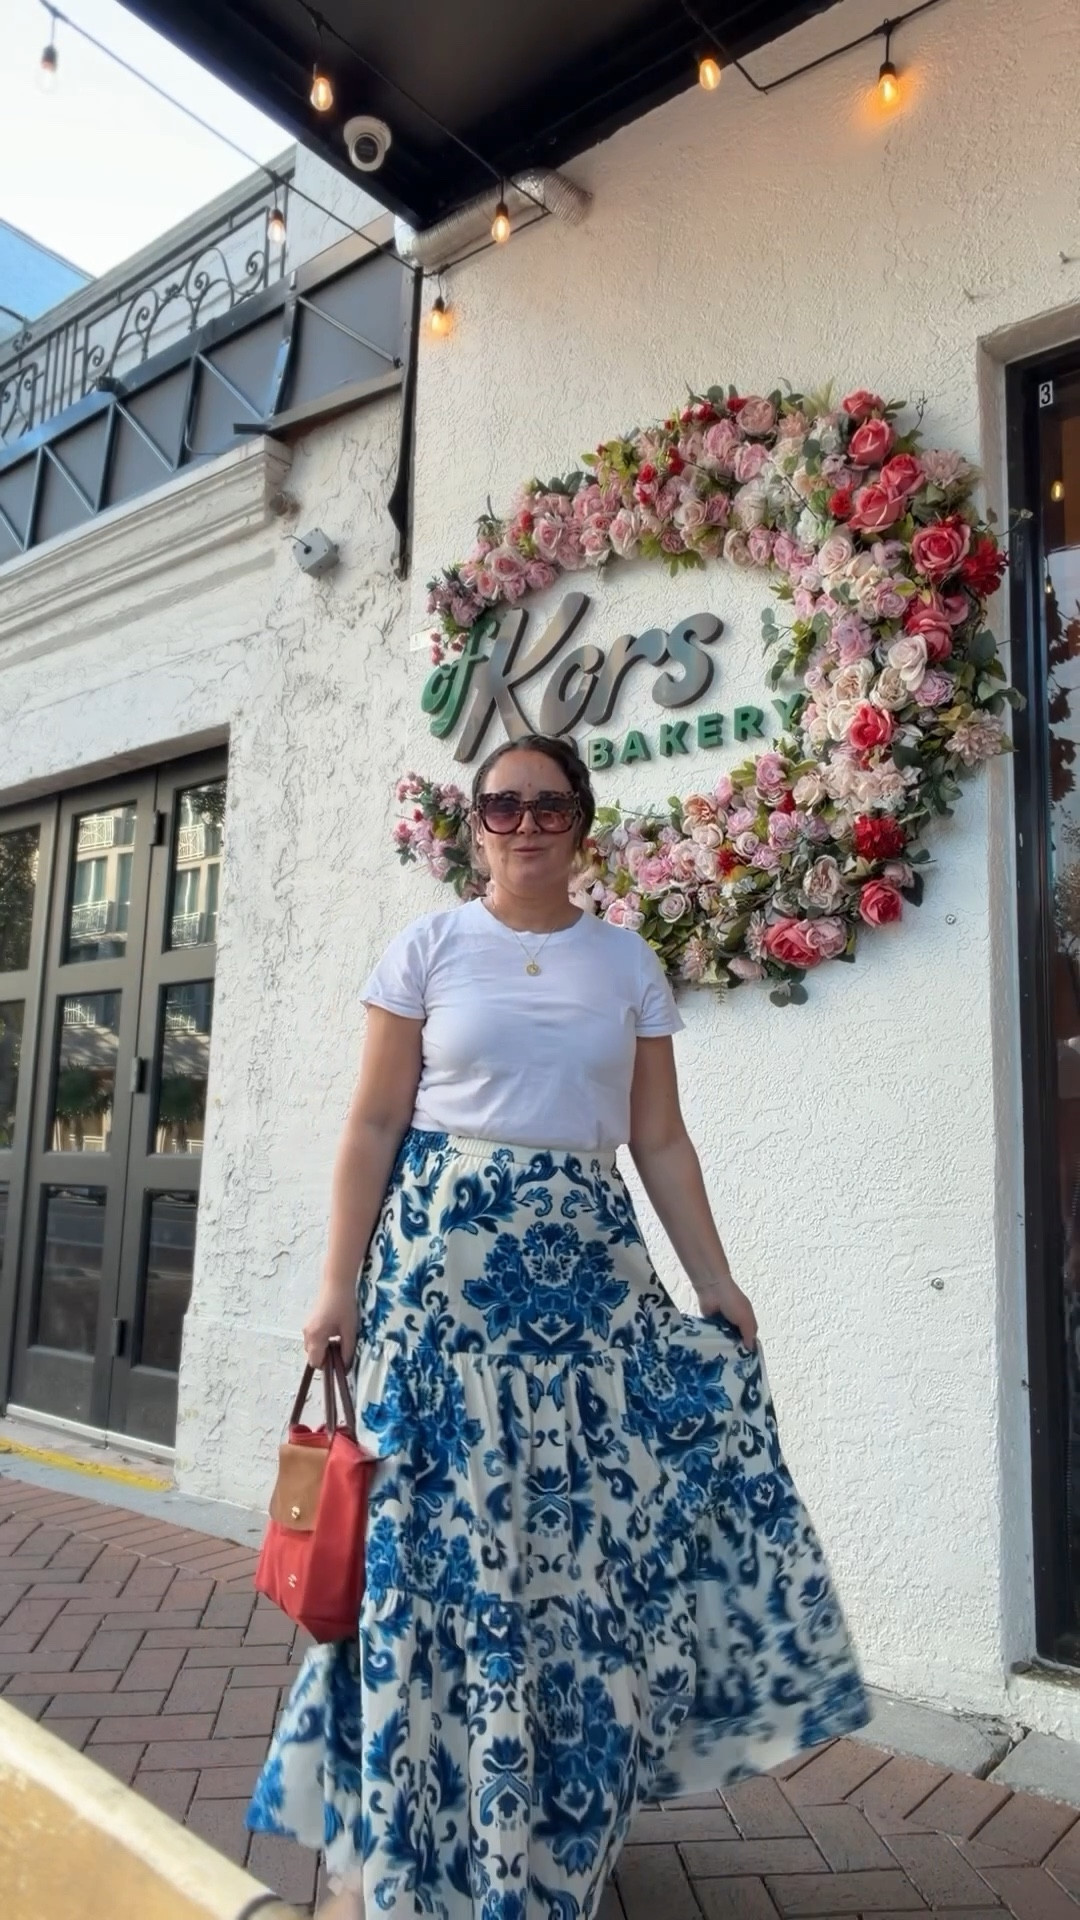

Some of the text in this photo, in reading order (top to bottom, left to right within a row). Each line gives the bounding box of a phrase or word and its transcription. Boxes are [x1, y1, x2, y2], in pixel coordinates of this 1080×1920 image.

[1040, 383, 1051, 405] 3
[453, 591, 724, 763] Kars
[587, 693, 805, 770] BAKERY
